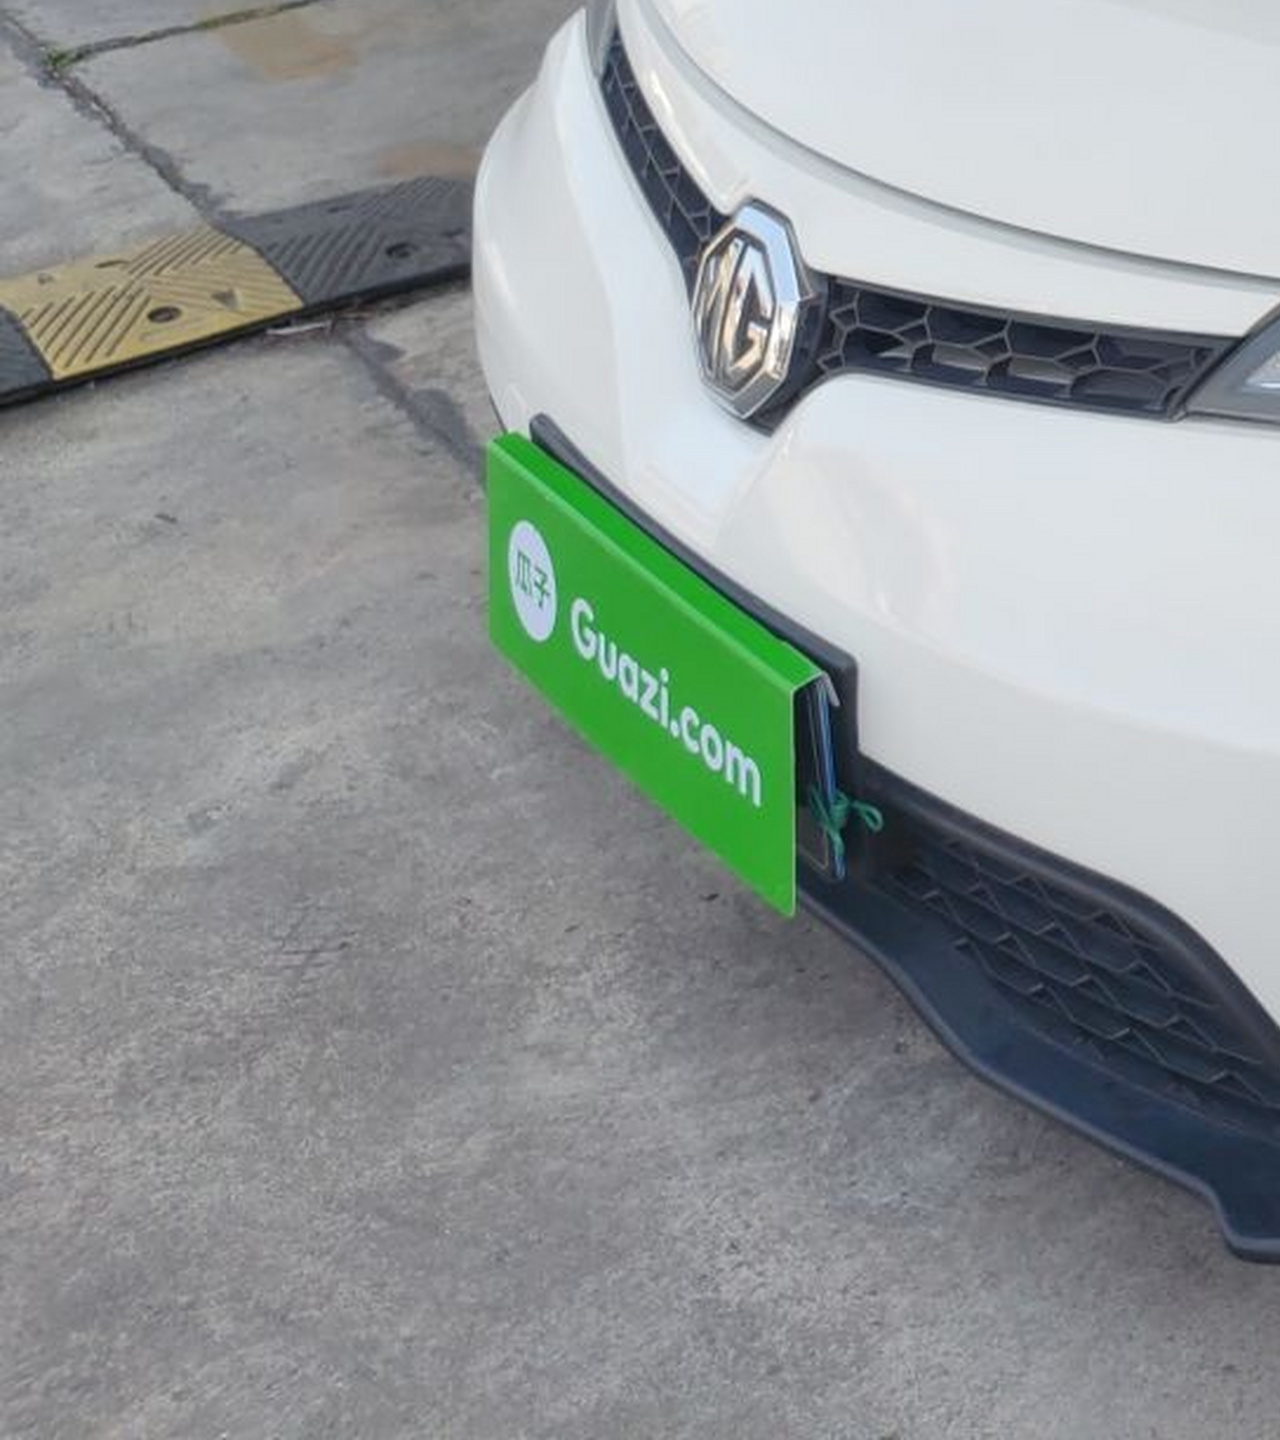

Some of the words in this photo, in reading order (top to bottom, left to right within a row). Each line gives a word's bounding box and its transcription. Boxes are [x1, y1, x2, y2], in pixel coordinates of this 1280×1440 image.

[701, 230, 778, 397] MG
[514, 549, 551, 610] 瓜子
[569, 596, 763, 809] Guazi.com
